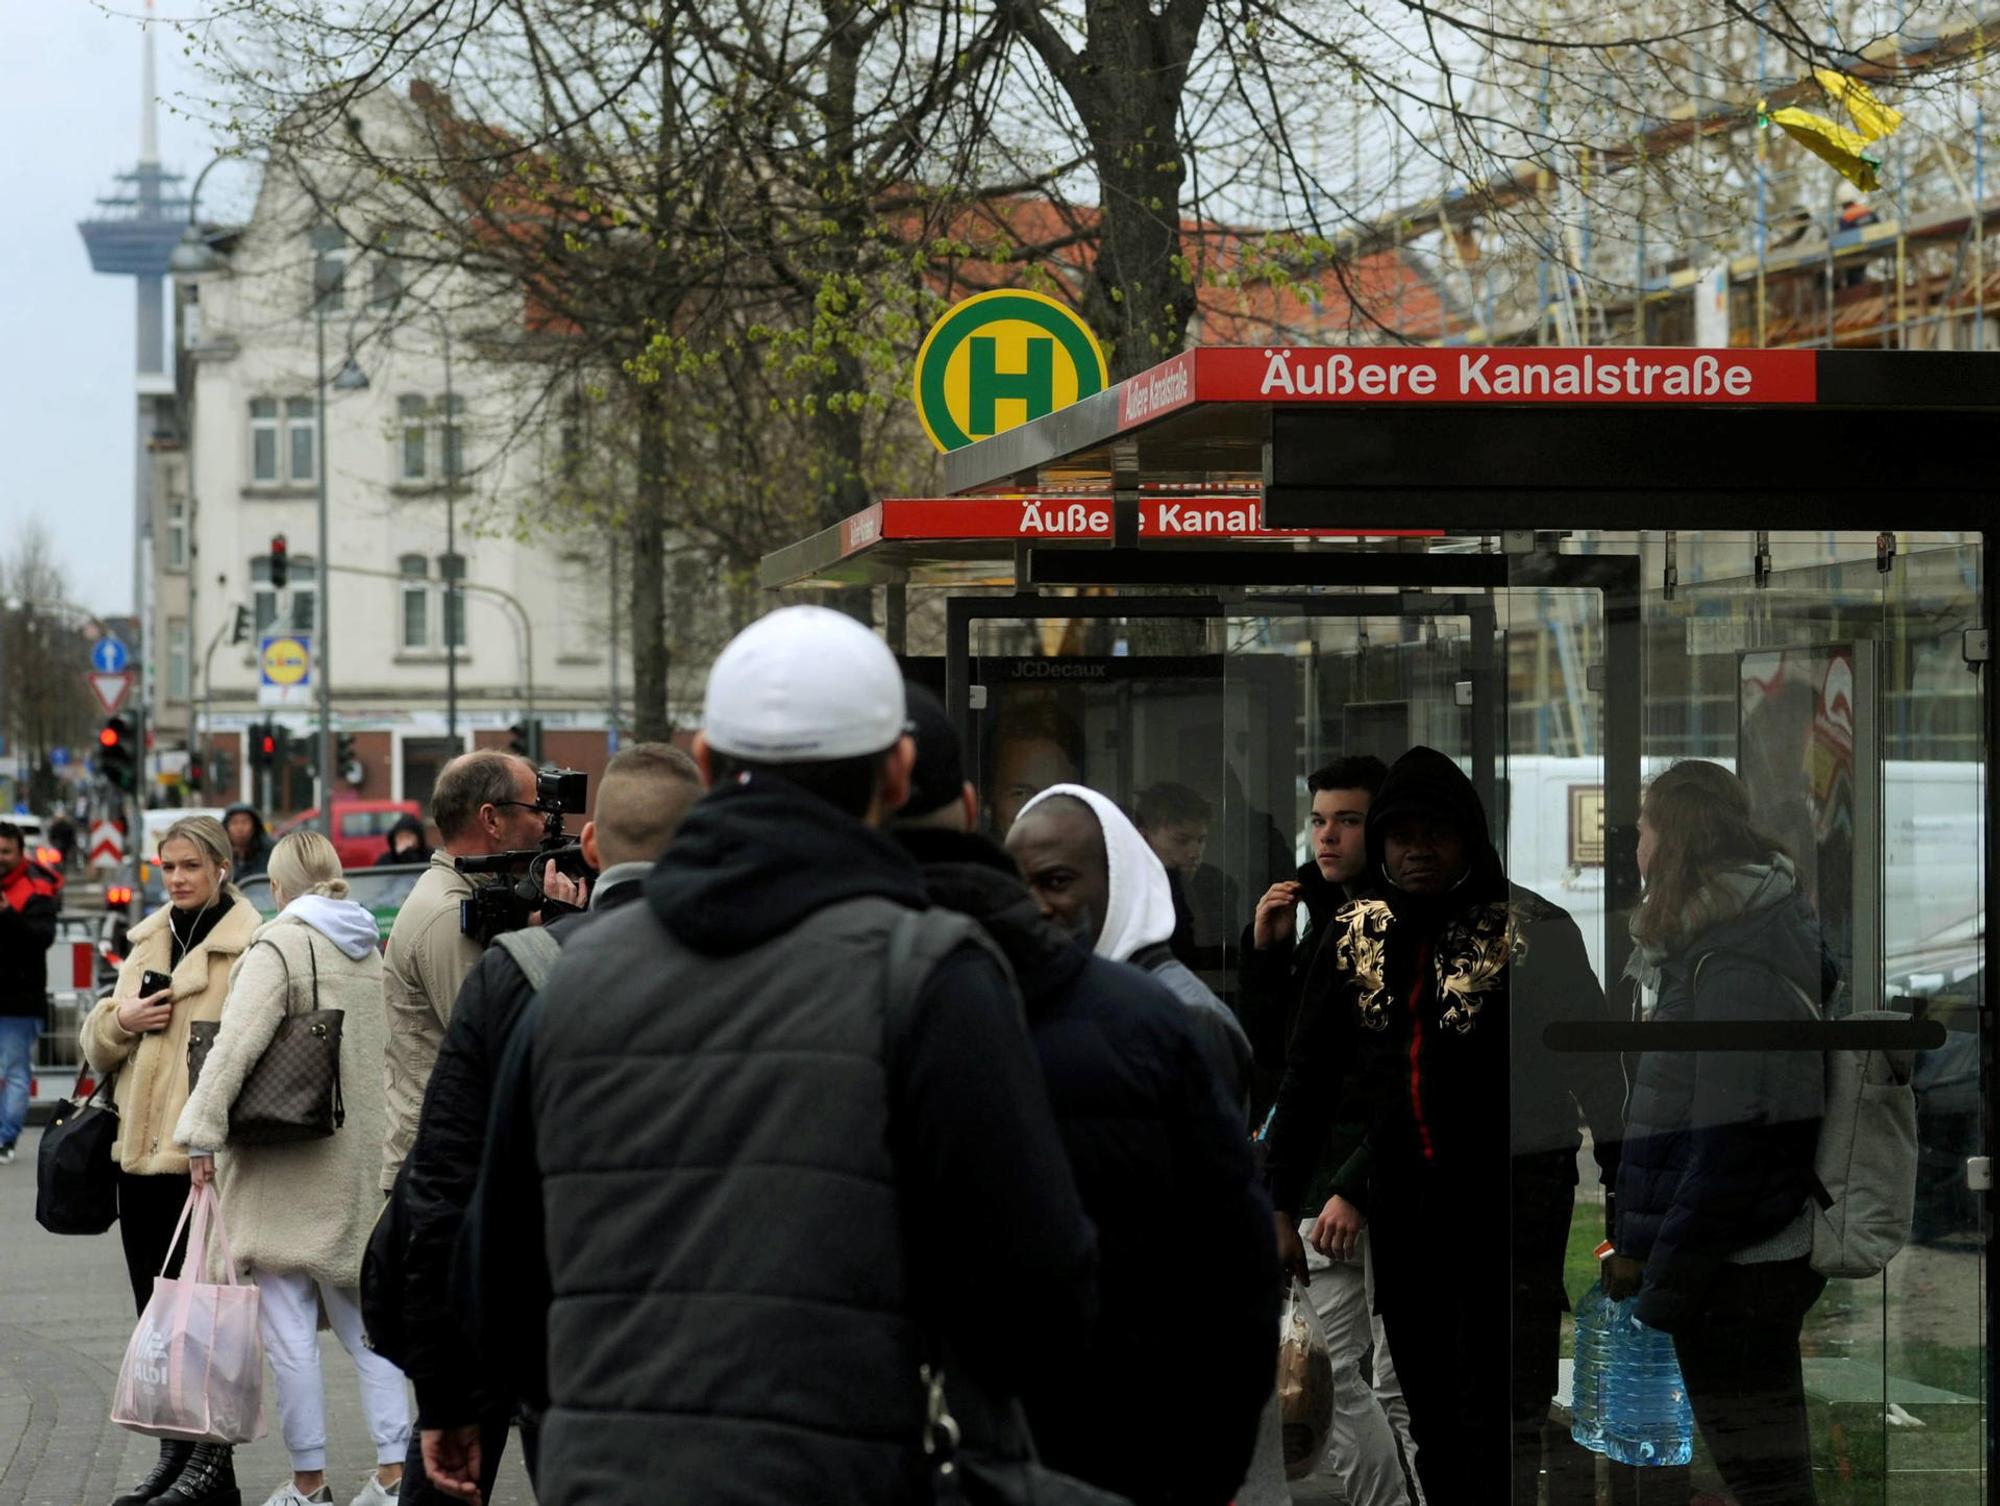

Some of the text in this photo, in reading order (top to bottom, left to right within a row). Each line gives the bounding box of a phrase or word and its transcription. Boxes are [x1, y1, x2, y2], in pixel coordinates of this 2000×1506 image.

[970, 336, 1053, 435] H
[1260, 349, 1753, 396] Äußere Kanalstraße
[1159, 504, 1266, 533] Kanal
[1011, 661, 1106, 678] JCDecaux
